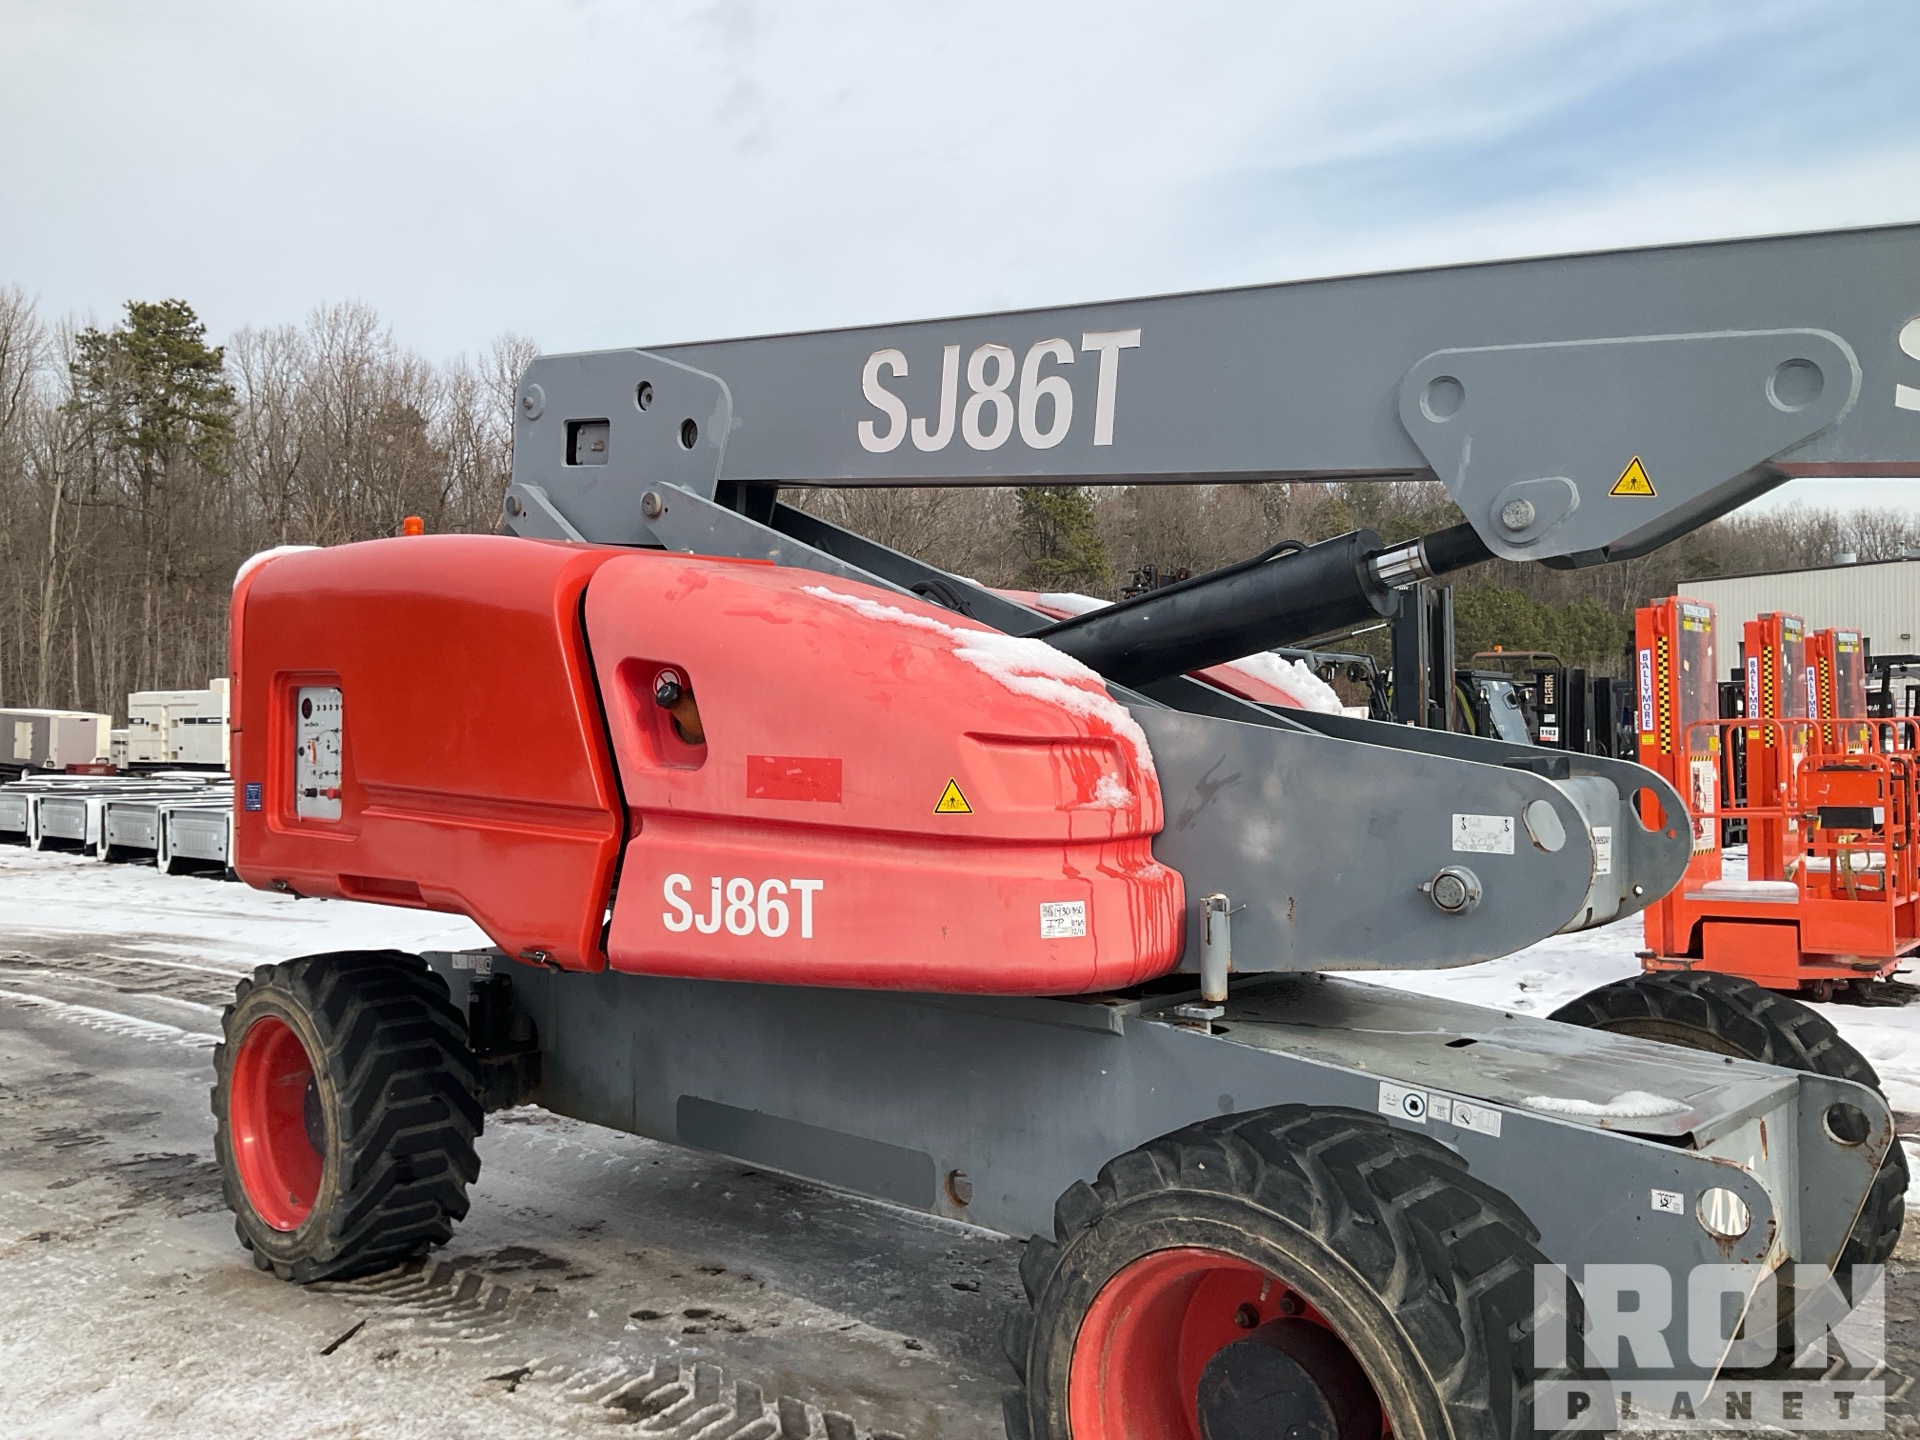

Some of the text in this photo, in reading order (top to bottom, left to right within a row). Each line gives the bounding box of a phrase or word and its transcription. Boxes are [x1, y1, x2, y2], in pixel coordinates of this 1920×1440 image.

[858, 328, 1141, 453] SJ86T
[1544, 674, 1554, 705] CLARK
[1642, 653, 1651, 728] BALLYMORE
[1749, 660, 1758, 717] BALLYMOR
[1808, 669, 1816, 718] BALLYMOR
[663, 873, 823, 938] SJ86T
